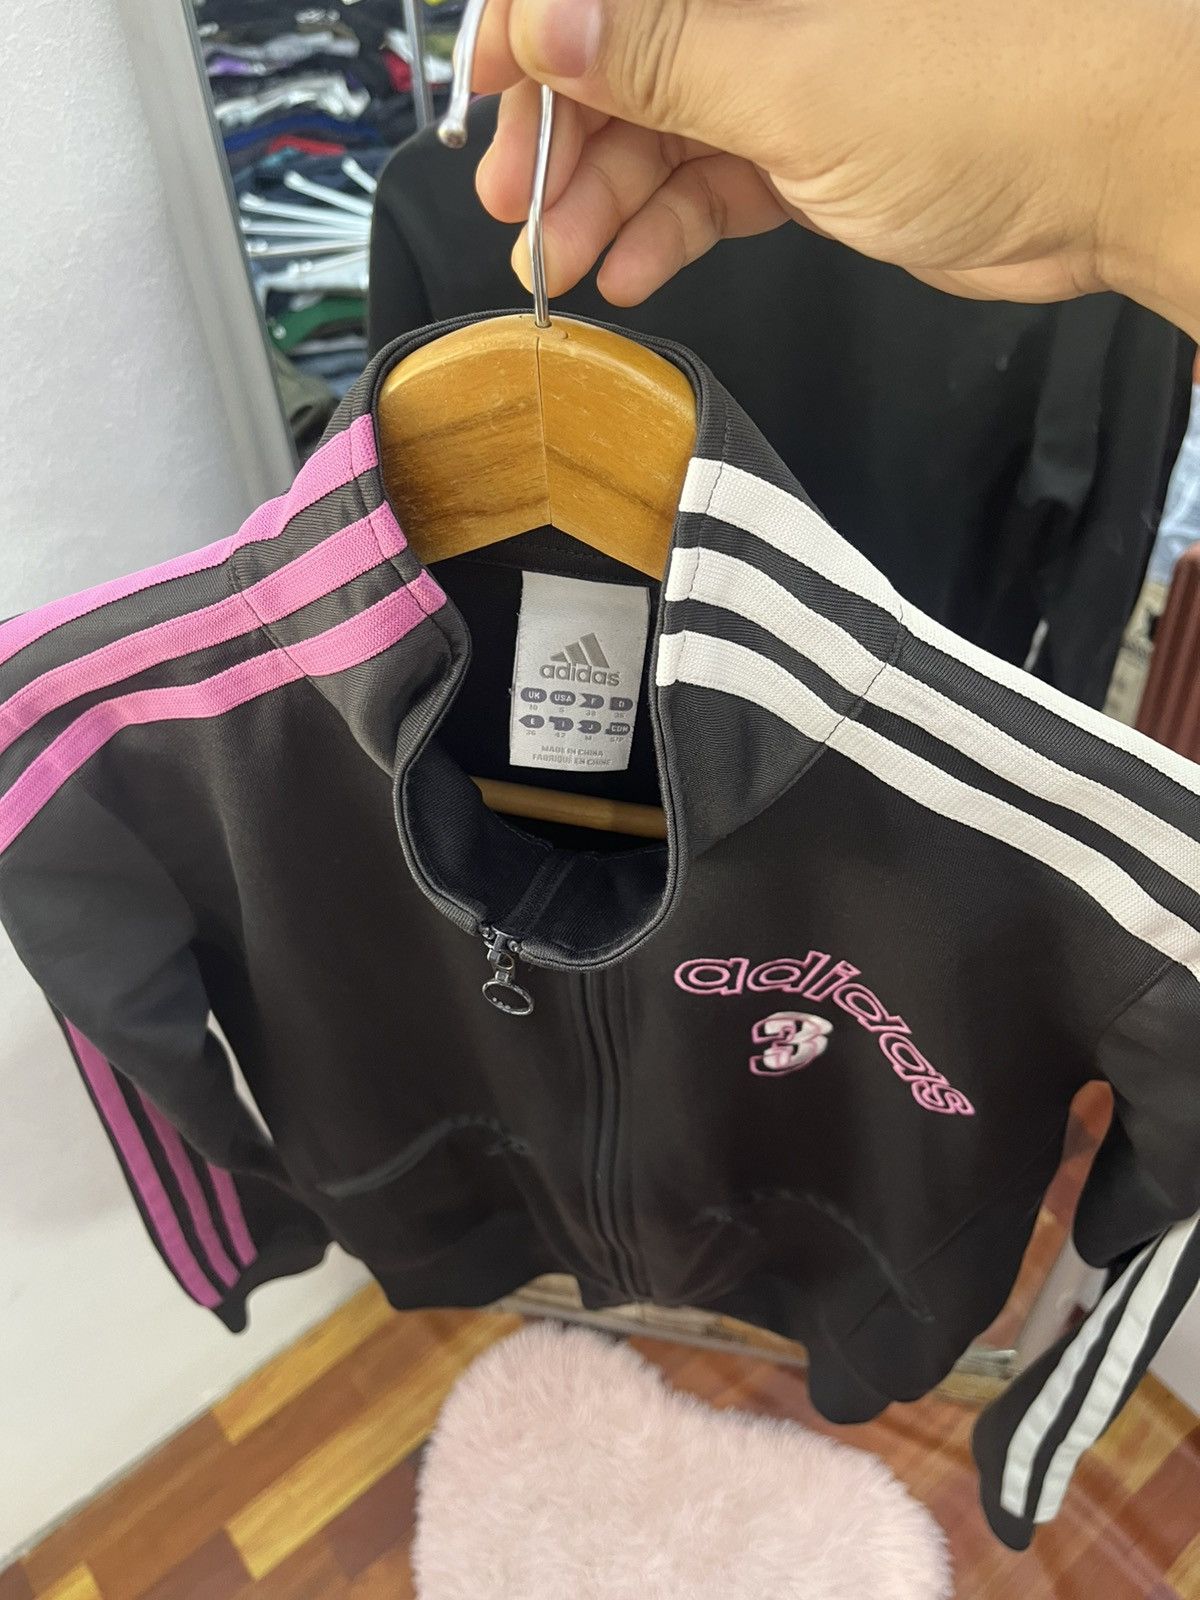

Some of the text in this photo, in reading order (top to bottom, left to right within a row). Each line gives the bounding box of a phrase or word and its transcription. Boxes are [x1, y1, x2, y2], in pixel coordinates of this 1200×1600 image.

[540, 662, 620, 687] adidas
[528, 690, 540, 700] UK
[554, 694, 572, 702] USA
[532, 753, 612, 766] FABRIQUE EN CHINE
[541, 745, 604, 757] MADE IN CHINA
[673, 950, 976, 1116] adidas
[750, 1011, 833, 1077] 3
